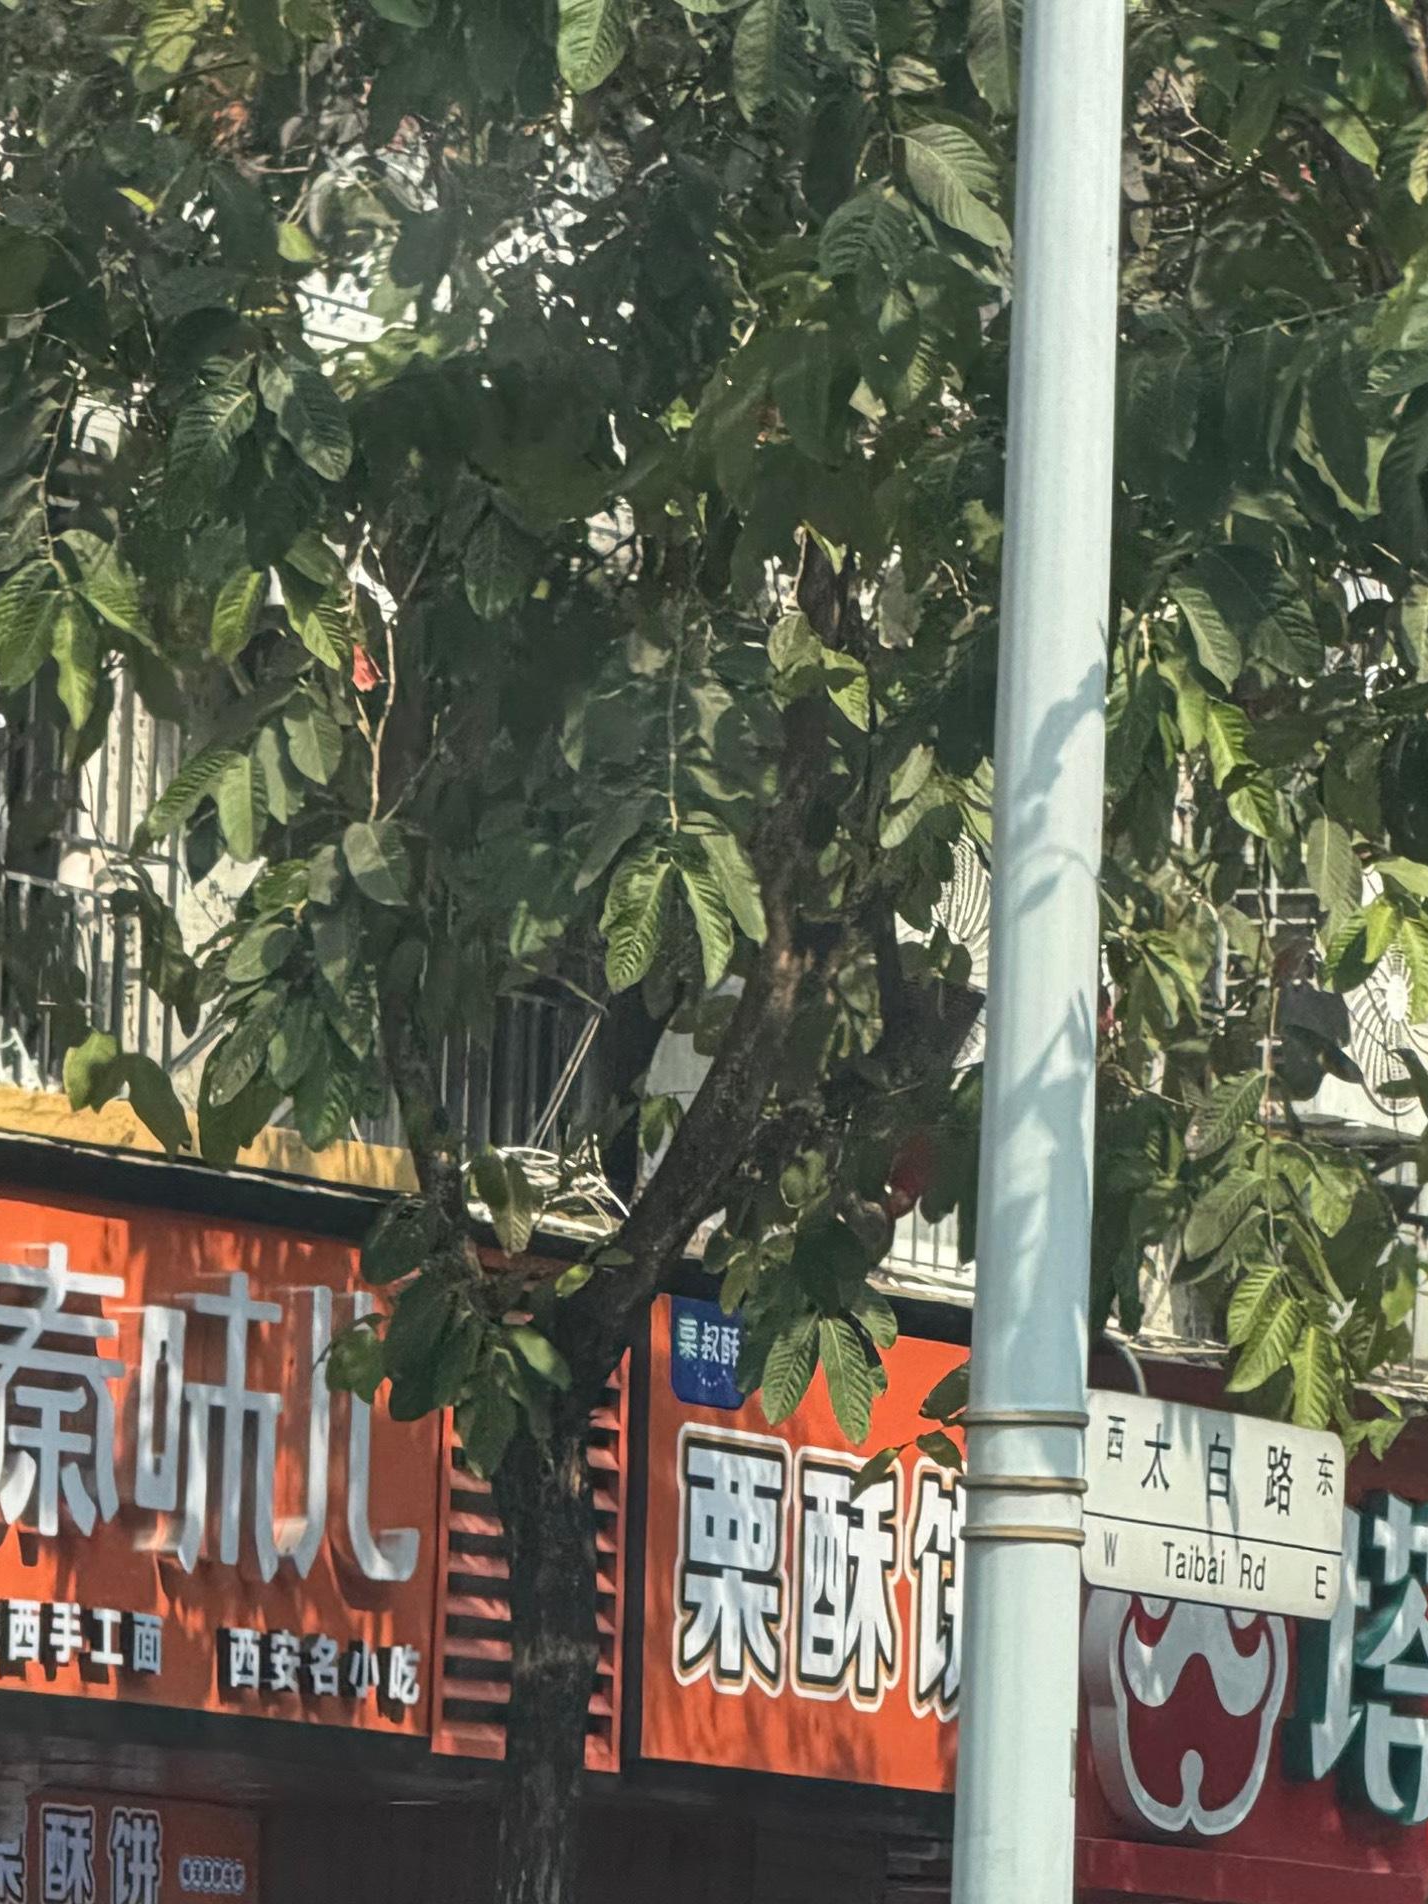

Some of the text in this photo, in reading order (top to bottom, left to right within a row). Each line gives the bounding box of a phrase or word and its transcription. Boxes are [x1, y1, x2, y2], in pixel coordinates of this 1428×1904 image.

[1140, 1422, 1294, 1517] 太白路
[1316, 1452, 1335, 1496] 东
[1103, 1530, 1328, 1600] W Taibai Rd E
[228, 1626, 422, 1706] 西安名小吃
